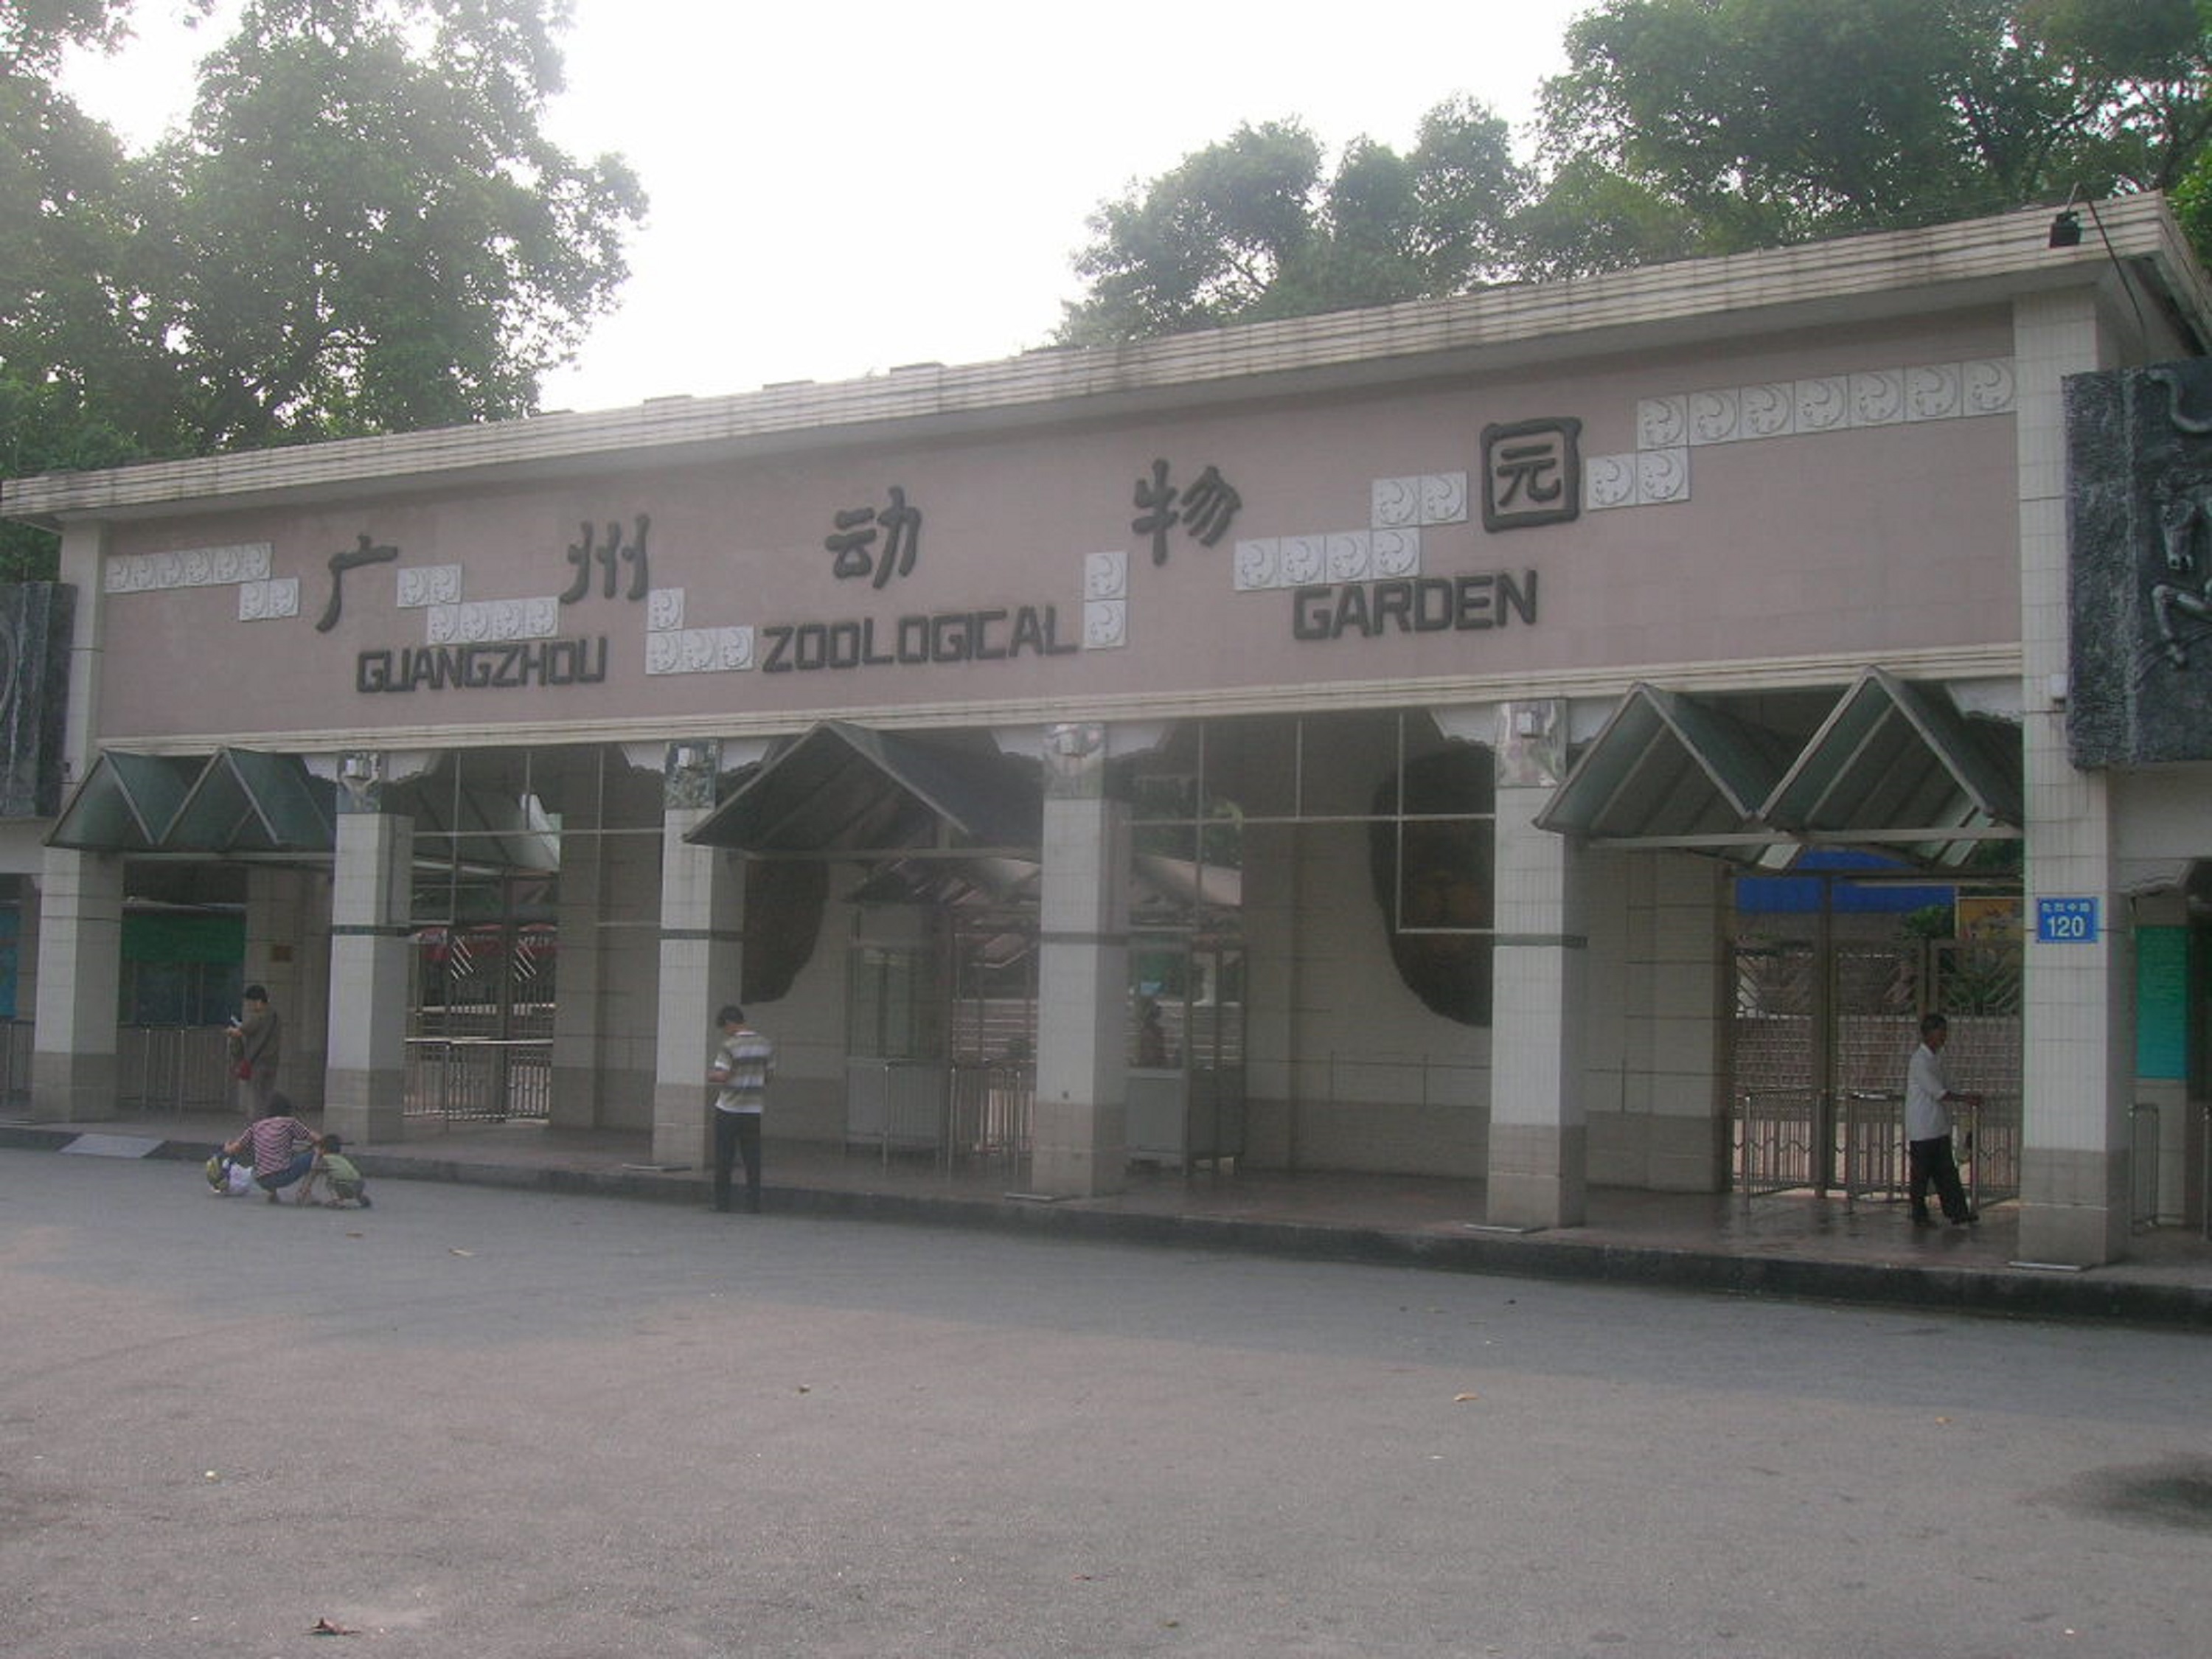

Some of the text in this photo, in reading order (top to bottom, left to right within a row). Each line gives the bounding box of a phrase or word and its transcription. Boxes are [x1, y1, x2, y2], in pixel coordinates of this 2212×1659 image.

[316, 417, 1582, 633] 广州动物园
[357, 569, 1537, 693] GUANGZHOU ZOOLOGICAL GARDEN
[2047, 916, 2084, 937] 120
